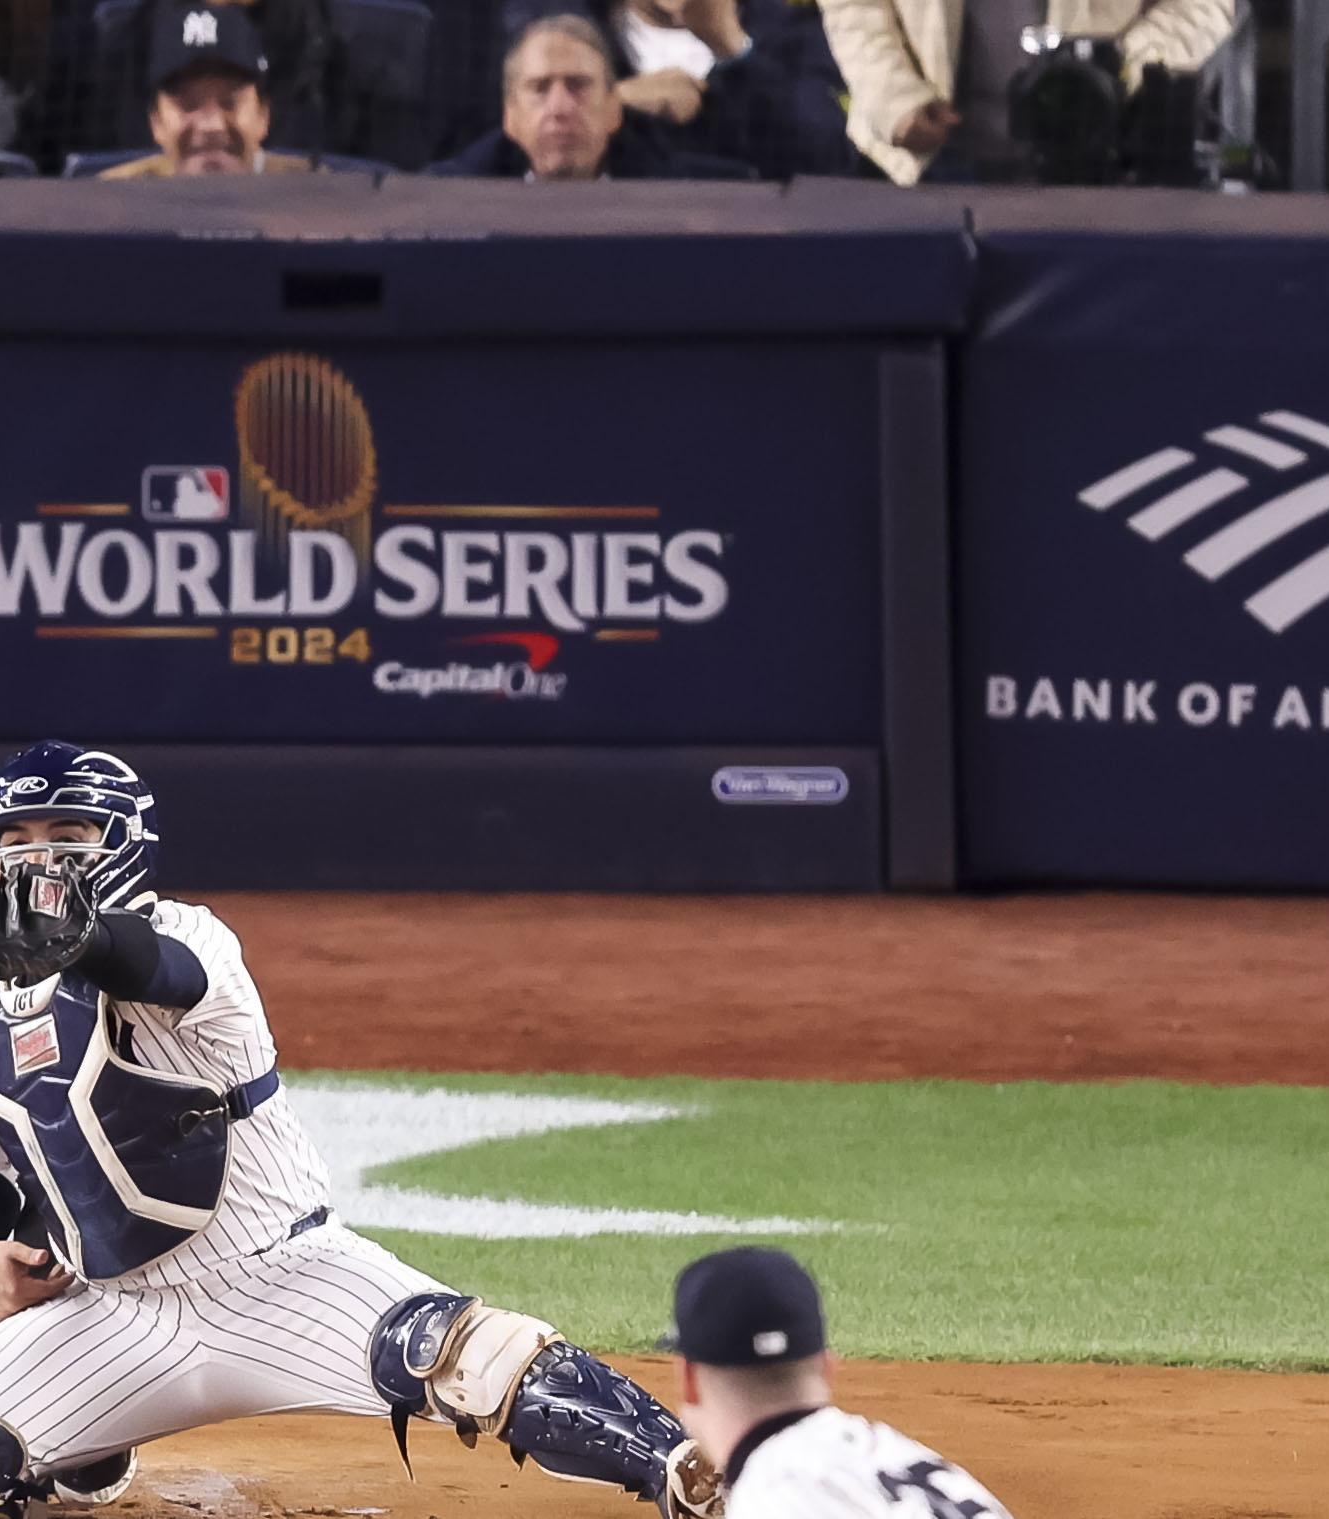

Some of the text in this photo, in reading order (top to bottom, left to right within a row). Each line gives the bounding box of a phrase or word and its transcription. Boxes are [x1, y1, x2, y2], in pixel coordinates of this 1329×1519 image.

[373, 524, 730, 632] SERIES
[230, 626, 372, 665] 2024
[986, 675, 1329, 730] BANK OF A
